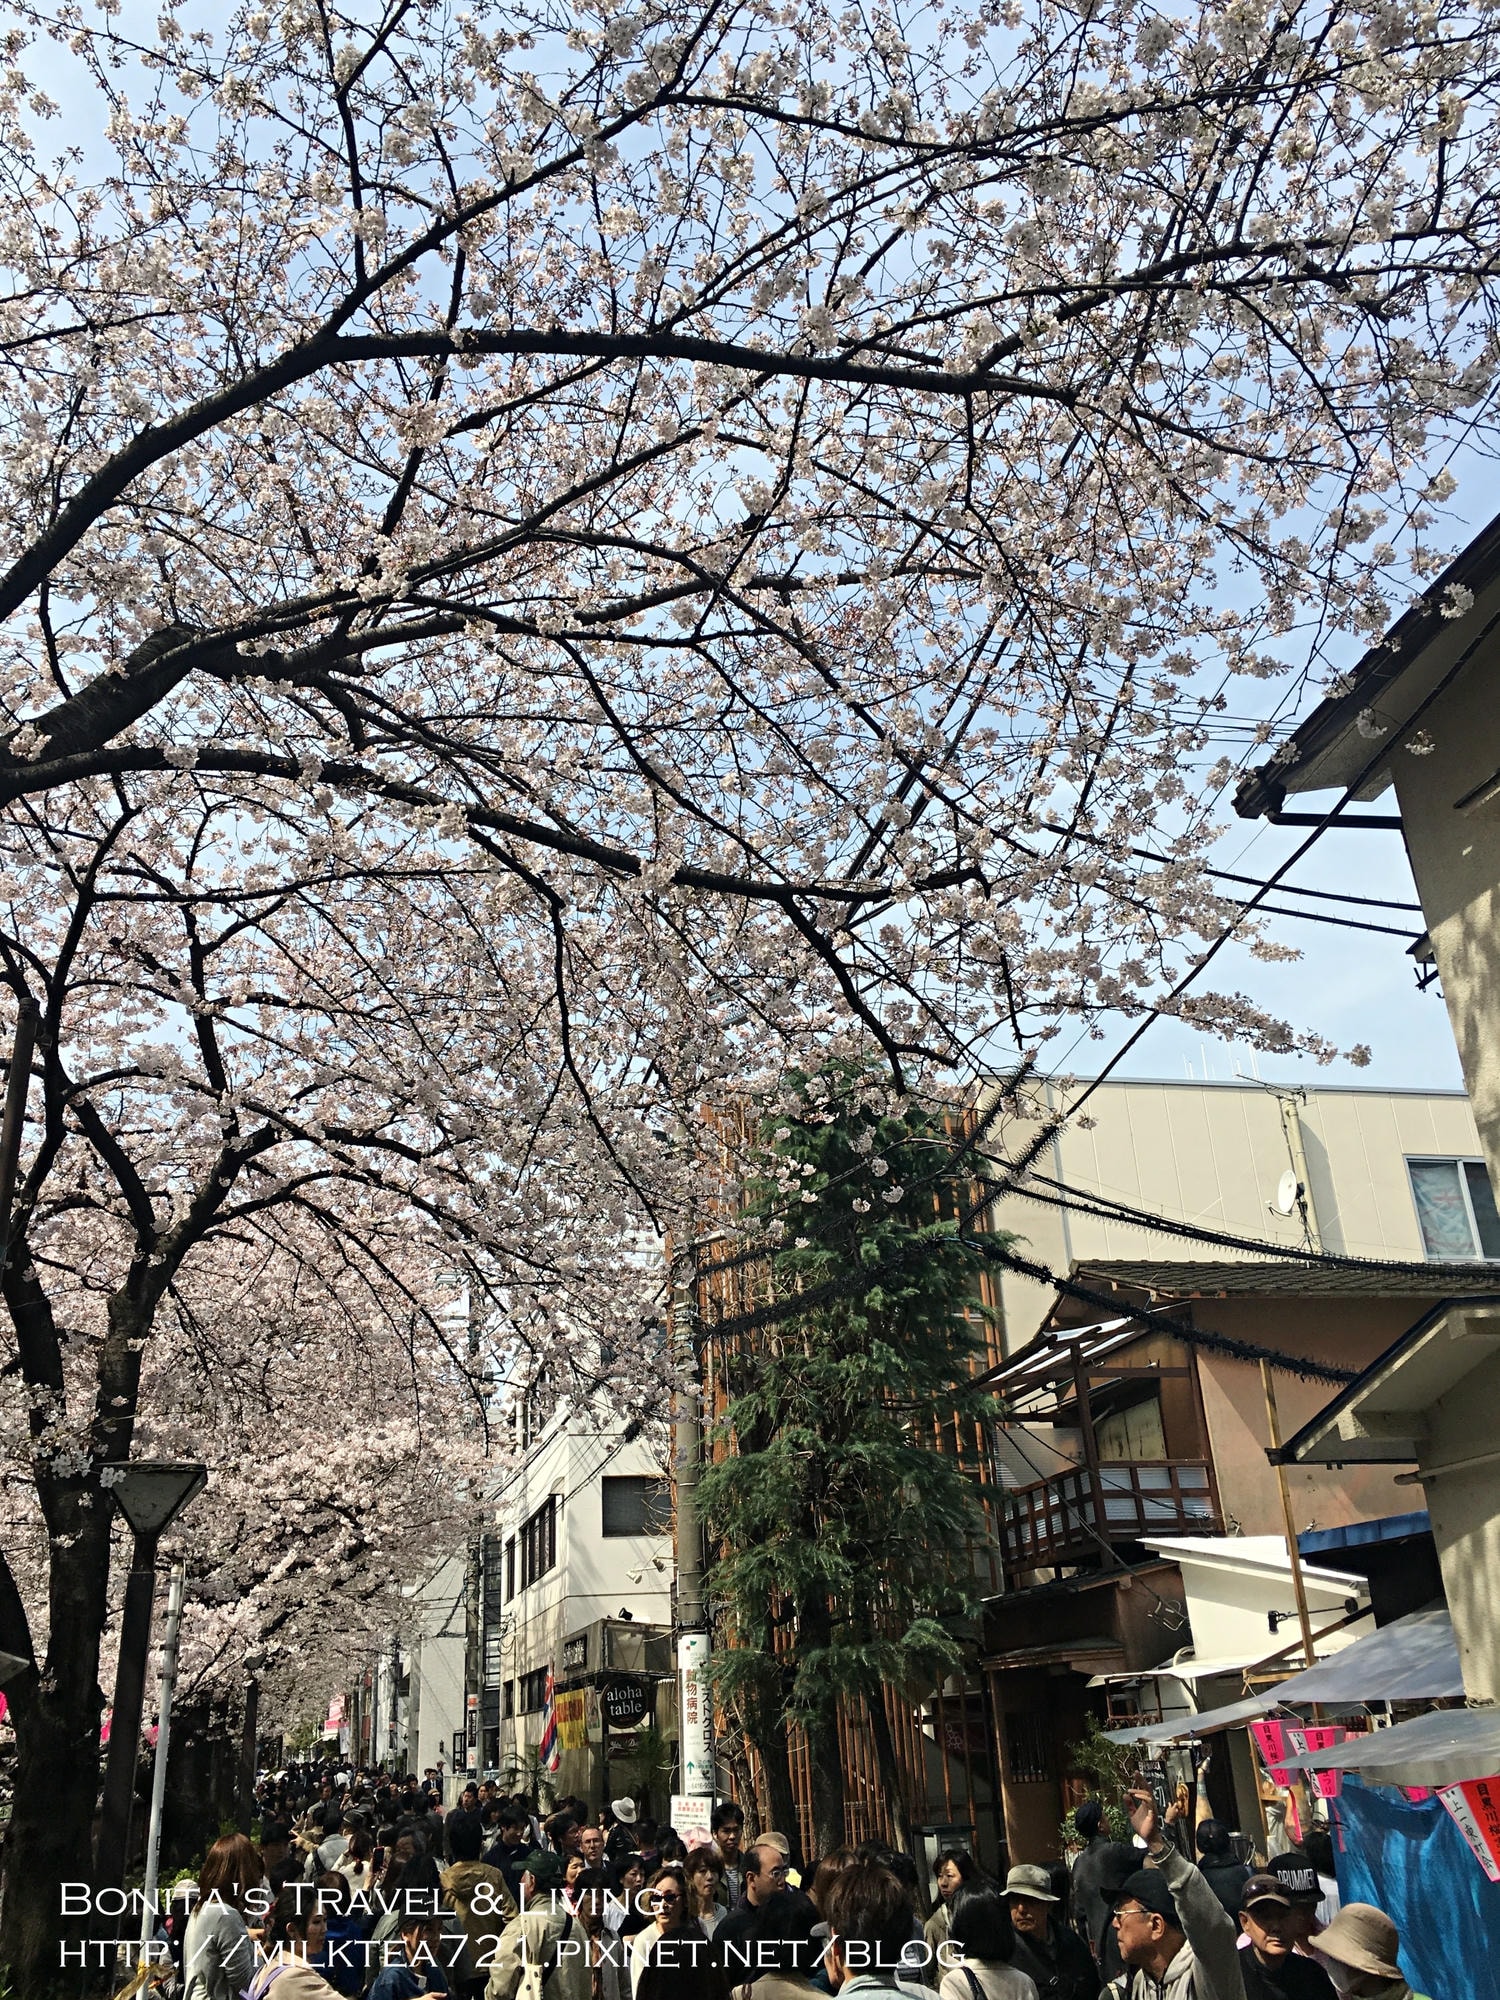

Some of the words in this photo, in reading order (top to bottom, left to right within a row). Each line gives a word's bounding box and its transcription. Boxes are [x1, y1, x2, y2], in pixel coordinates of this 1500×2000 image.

[606, 1685, 643, 1702] aloha
[610, 1700, 643, 1717] table
[1276, 1868, 1315, 1891] DRUMME
